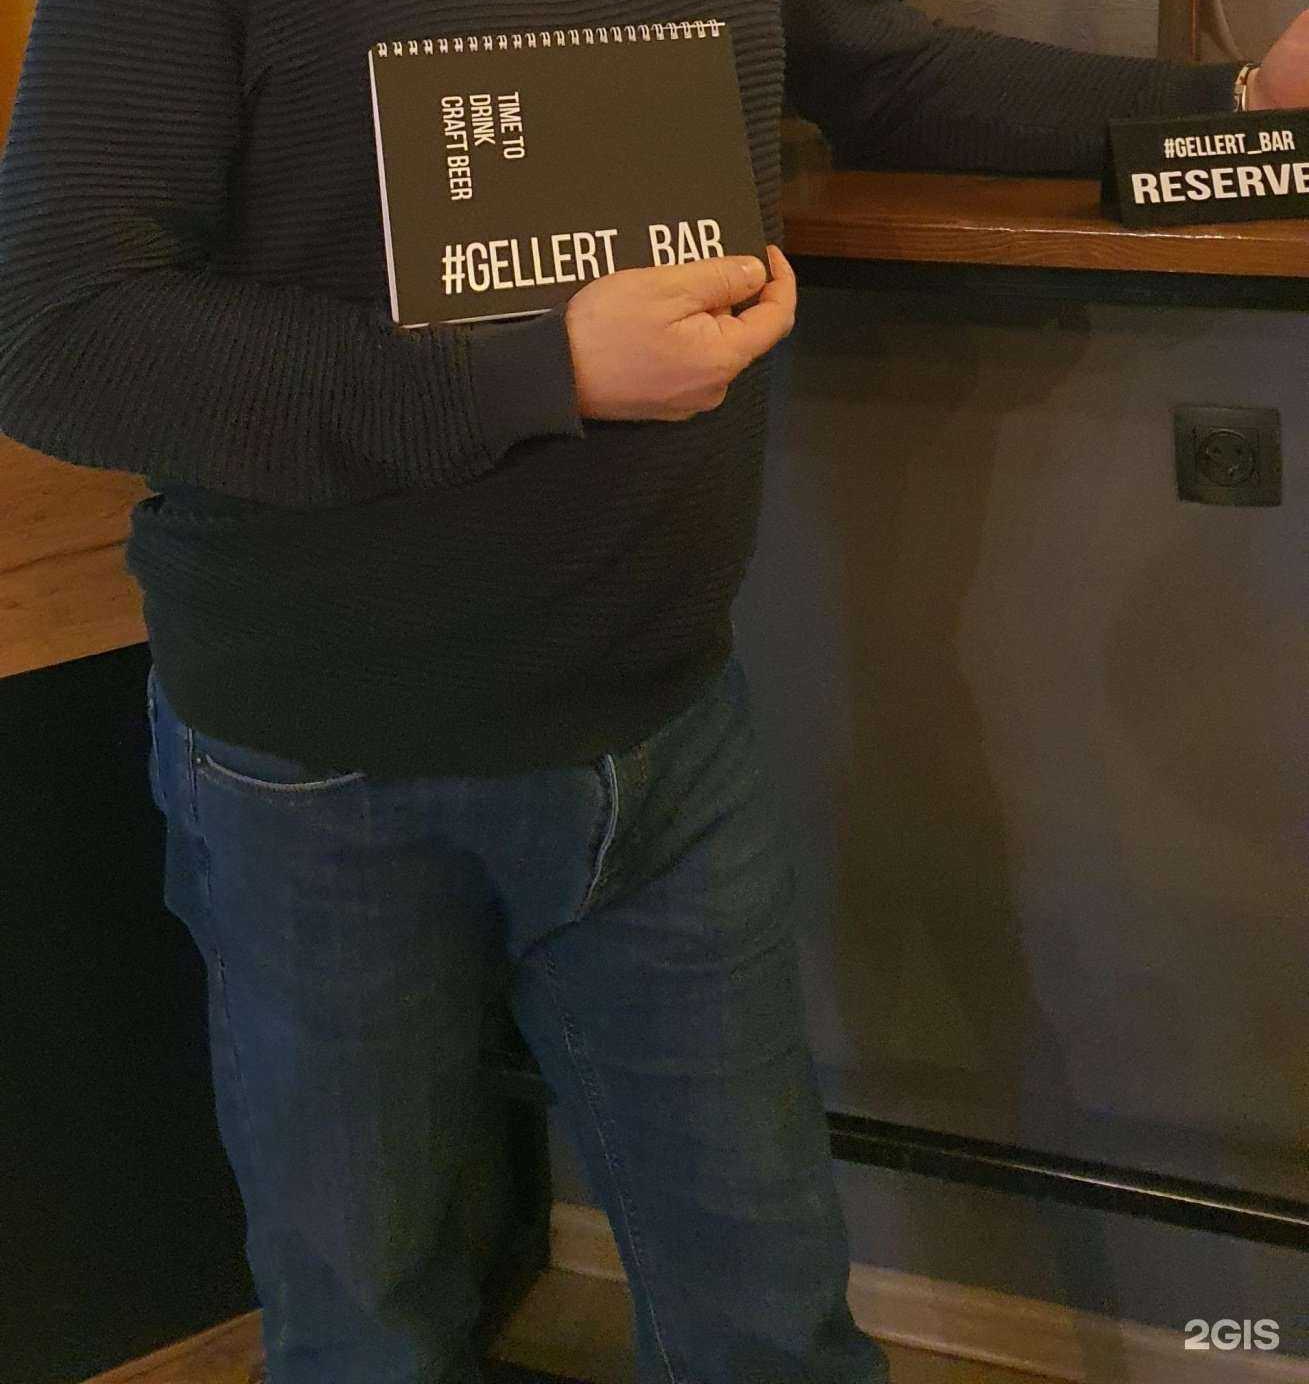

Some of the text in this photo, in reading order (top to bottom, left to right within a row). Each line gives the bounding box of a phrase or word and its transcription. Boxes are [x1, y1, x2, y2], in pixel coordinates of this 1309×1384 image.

[441, 96, 473, 201] CRAFT BEER
[469, 94, 496, 147] DRINK
[498, 91, 526, 160] TIME TO
[1163, 130, 1296, 159] #GELLERT_BAR
